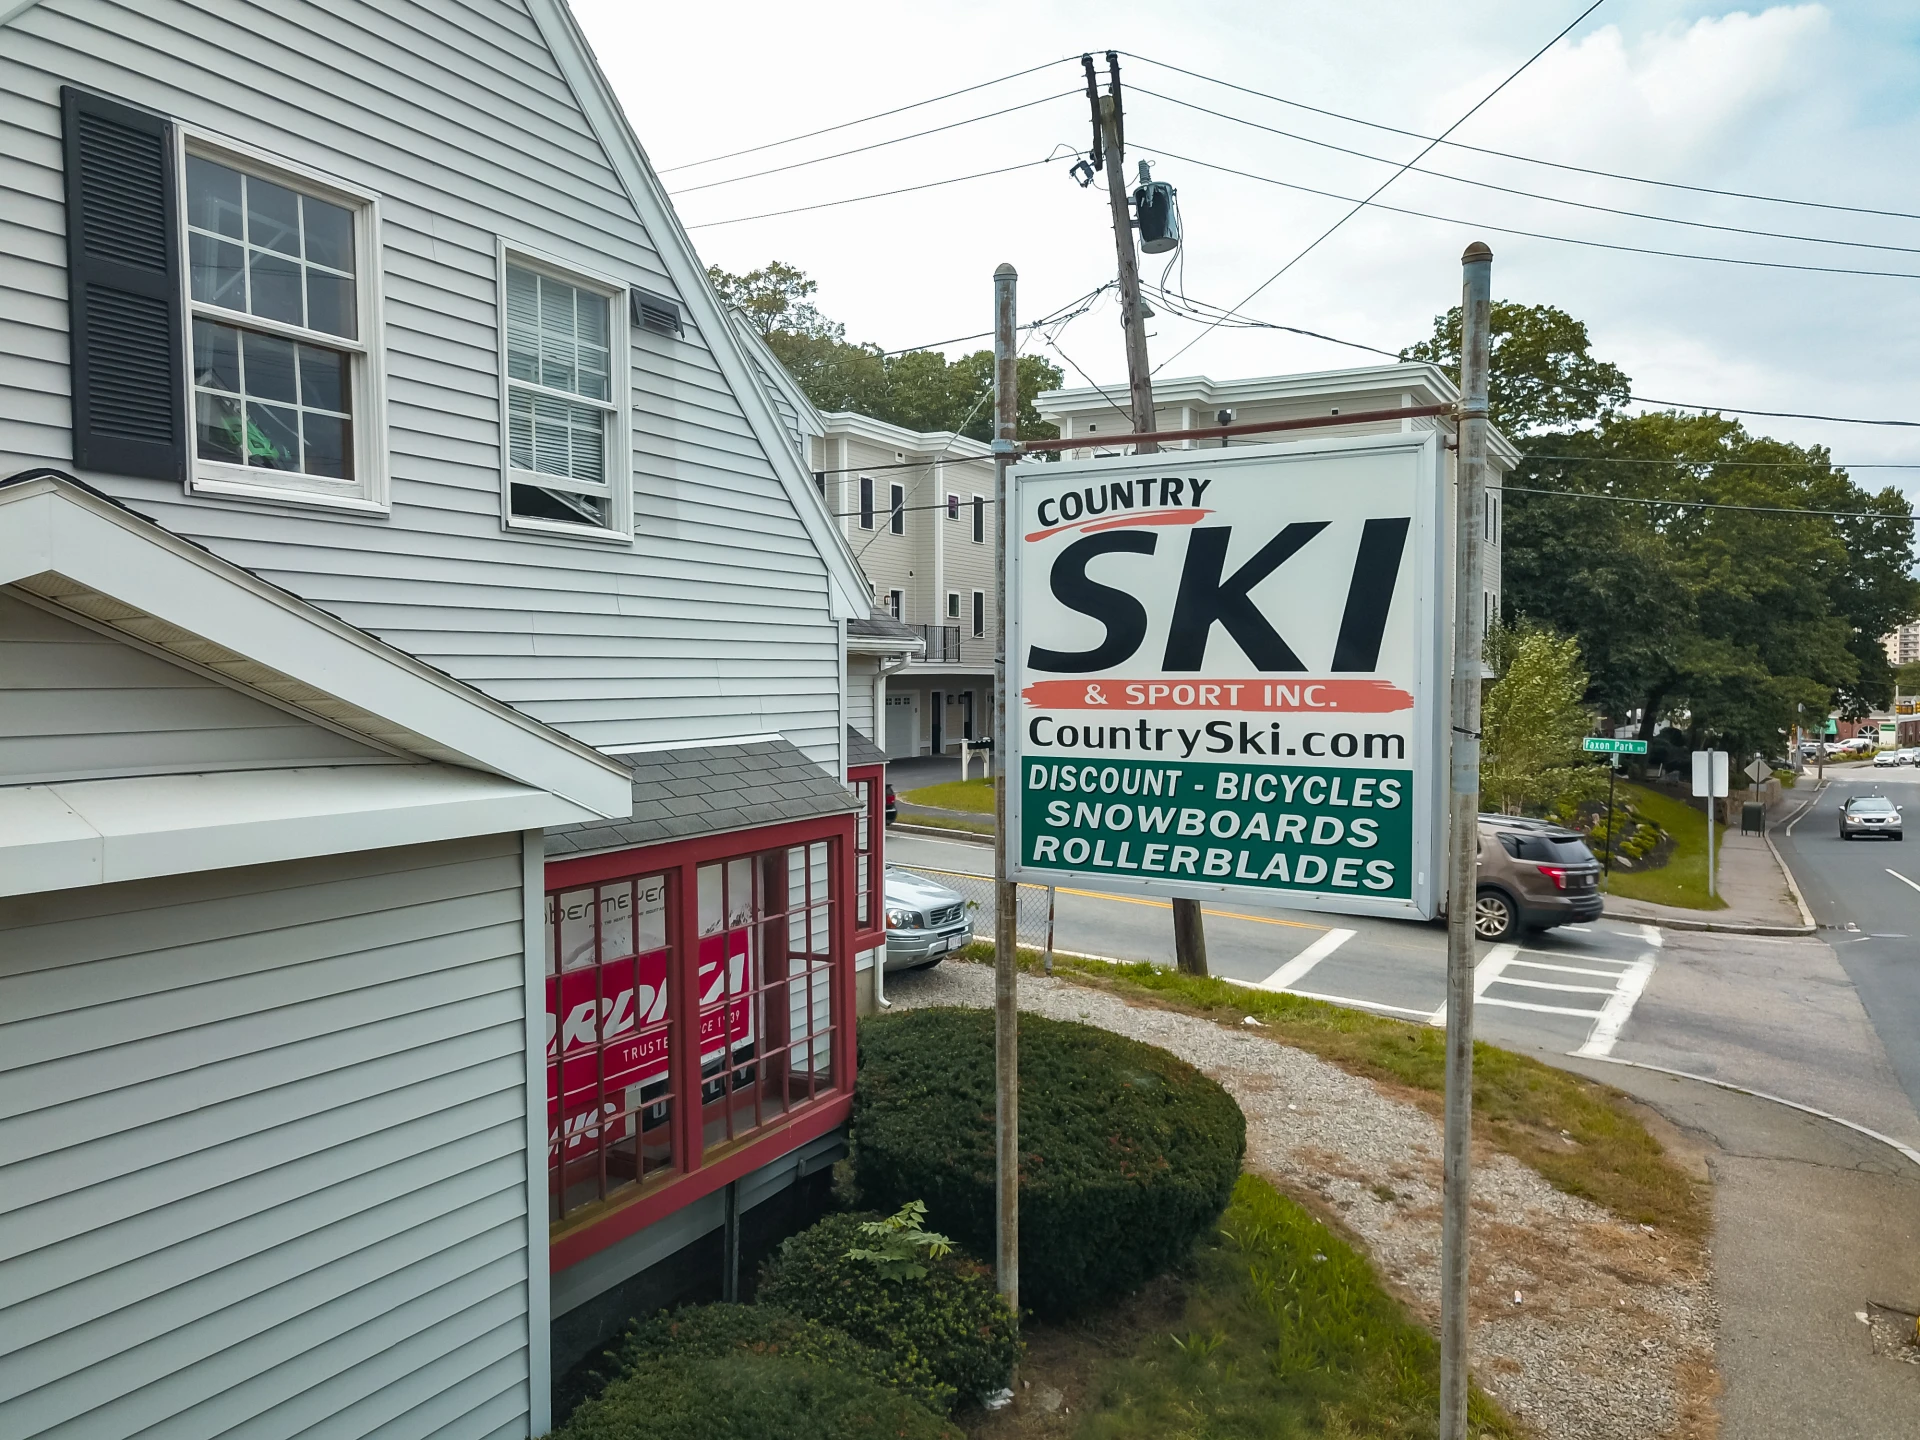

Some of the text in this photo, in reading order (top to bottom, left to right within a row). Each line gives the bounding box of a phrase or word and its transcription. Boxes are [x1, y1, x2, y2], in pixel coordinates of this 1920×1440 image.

[1037, 477, 1212, 528] COUNTRY
[1027, 517, 1412, 673] SKI
[1084, 684, 1338, 708] & SPORT INC.
[1029, 716, 1406, 760] CountrySki.com
[1585, 739, 1610, 750] Faxon
[1614, 741, 1633, 751] Park
[1029, 764, 1183, 797] DISCOUNT
[1216, 772, 1403, 810] BICYCLES
[1045, 800, 1379, 849] SNOWBOARDS
[1032, 835, 1396, 890] ROLLERBLADES
[623, 1039, 669, 1063] TRUSTE
